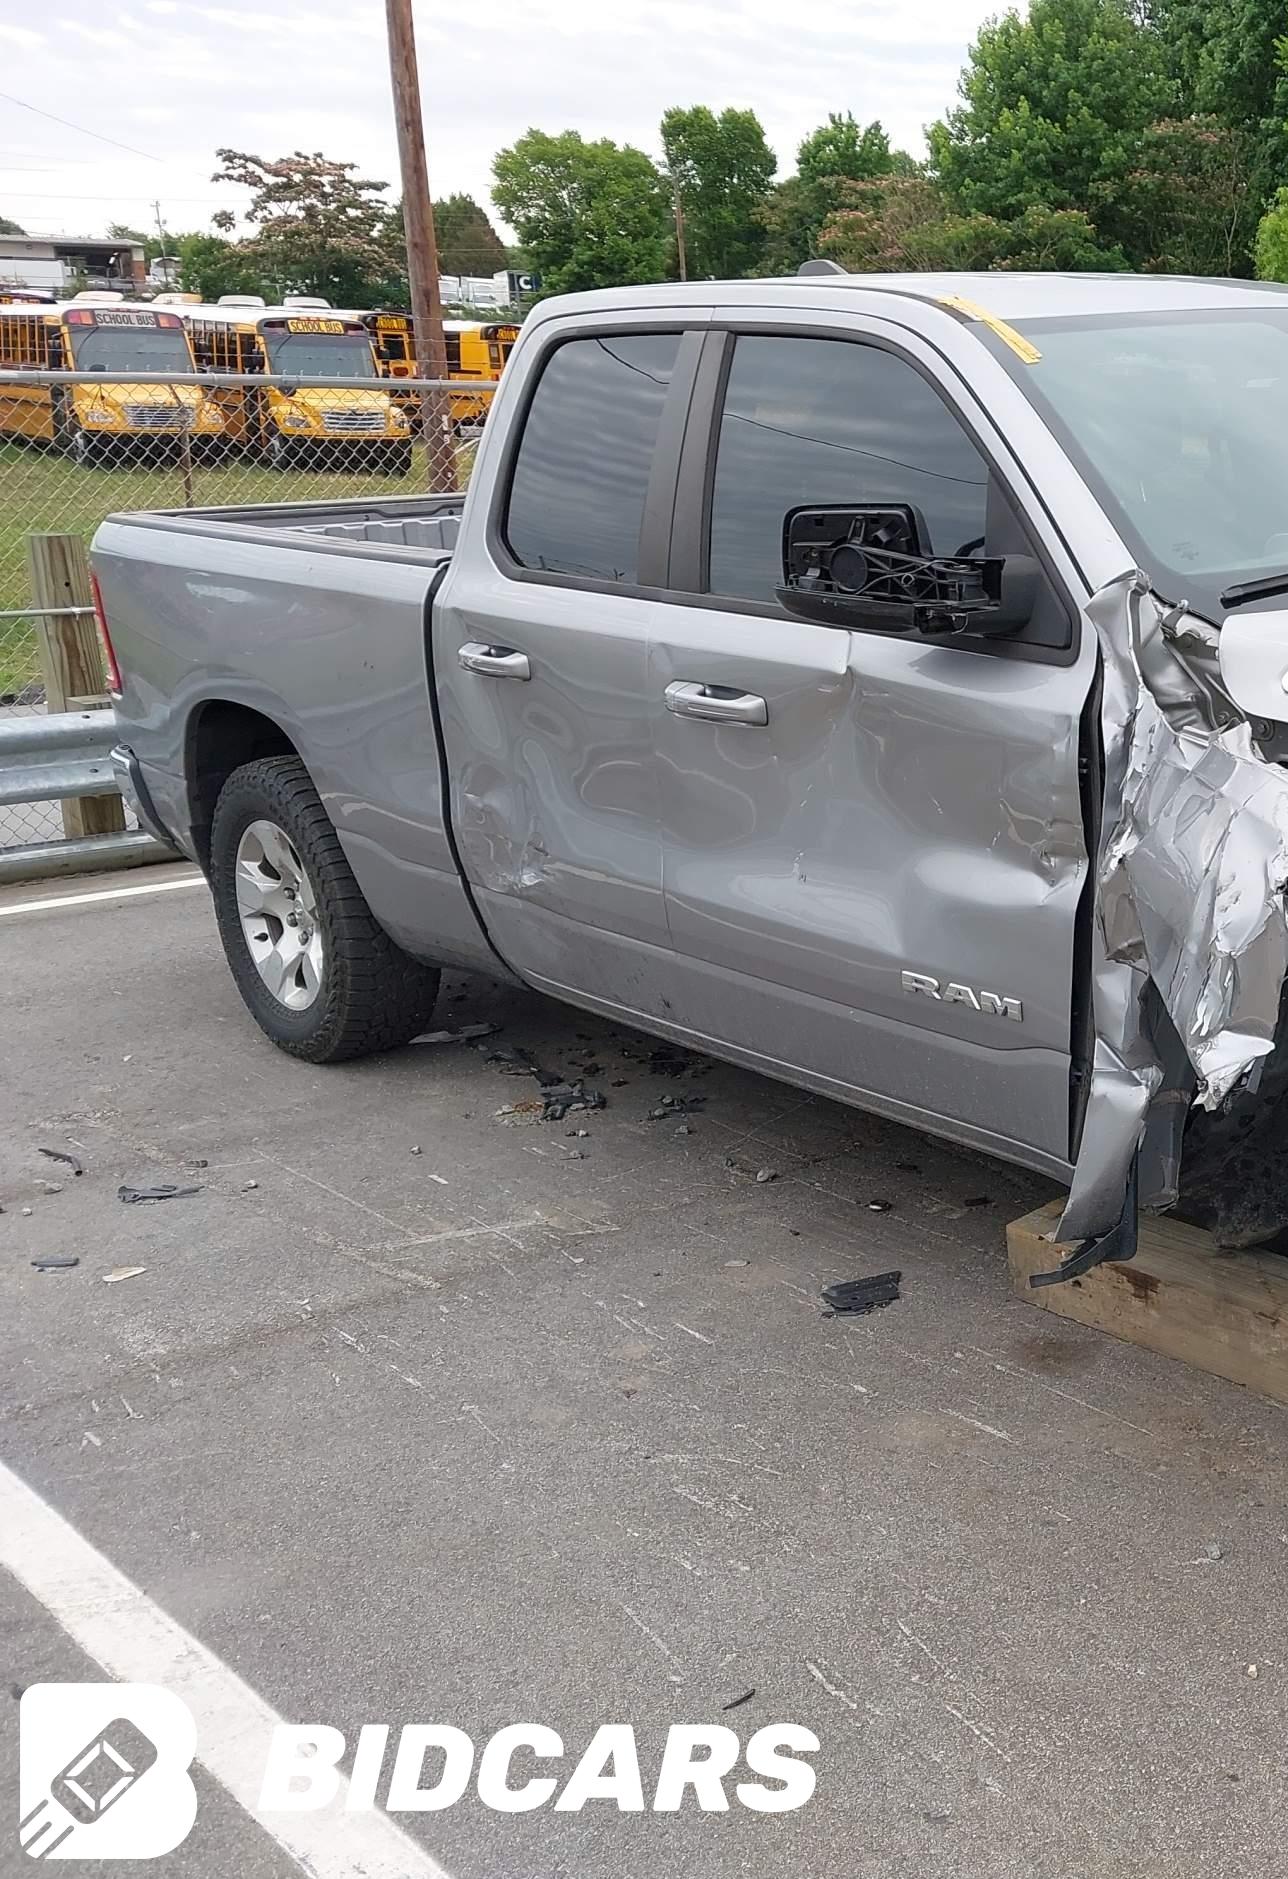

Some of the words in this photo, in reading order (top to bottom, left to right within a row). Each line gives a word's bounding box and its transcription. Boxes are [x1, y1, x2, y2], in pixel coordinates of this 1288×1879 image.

[96, 313, 135, 325] SCHOOL
[137, 314, 155, 326] BUS
[290, 320, 325, 332] SCHOOL
[326, 321, 342, 333] BUS
[901, 969, 1024, 1023] RAM
